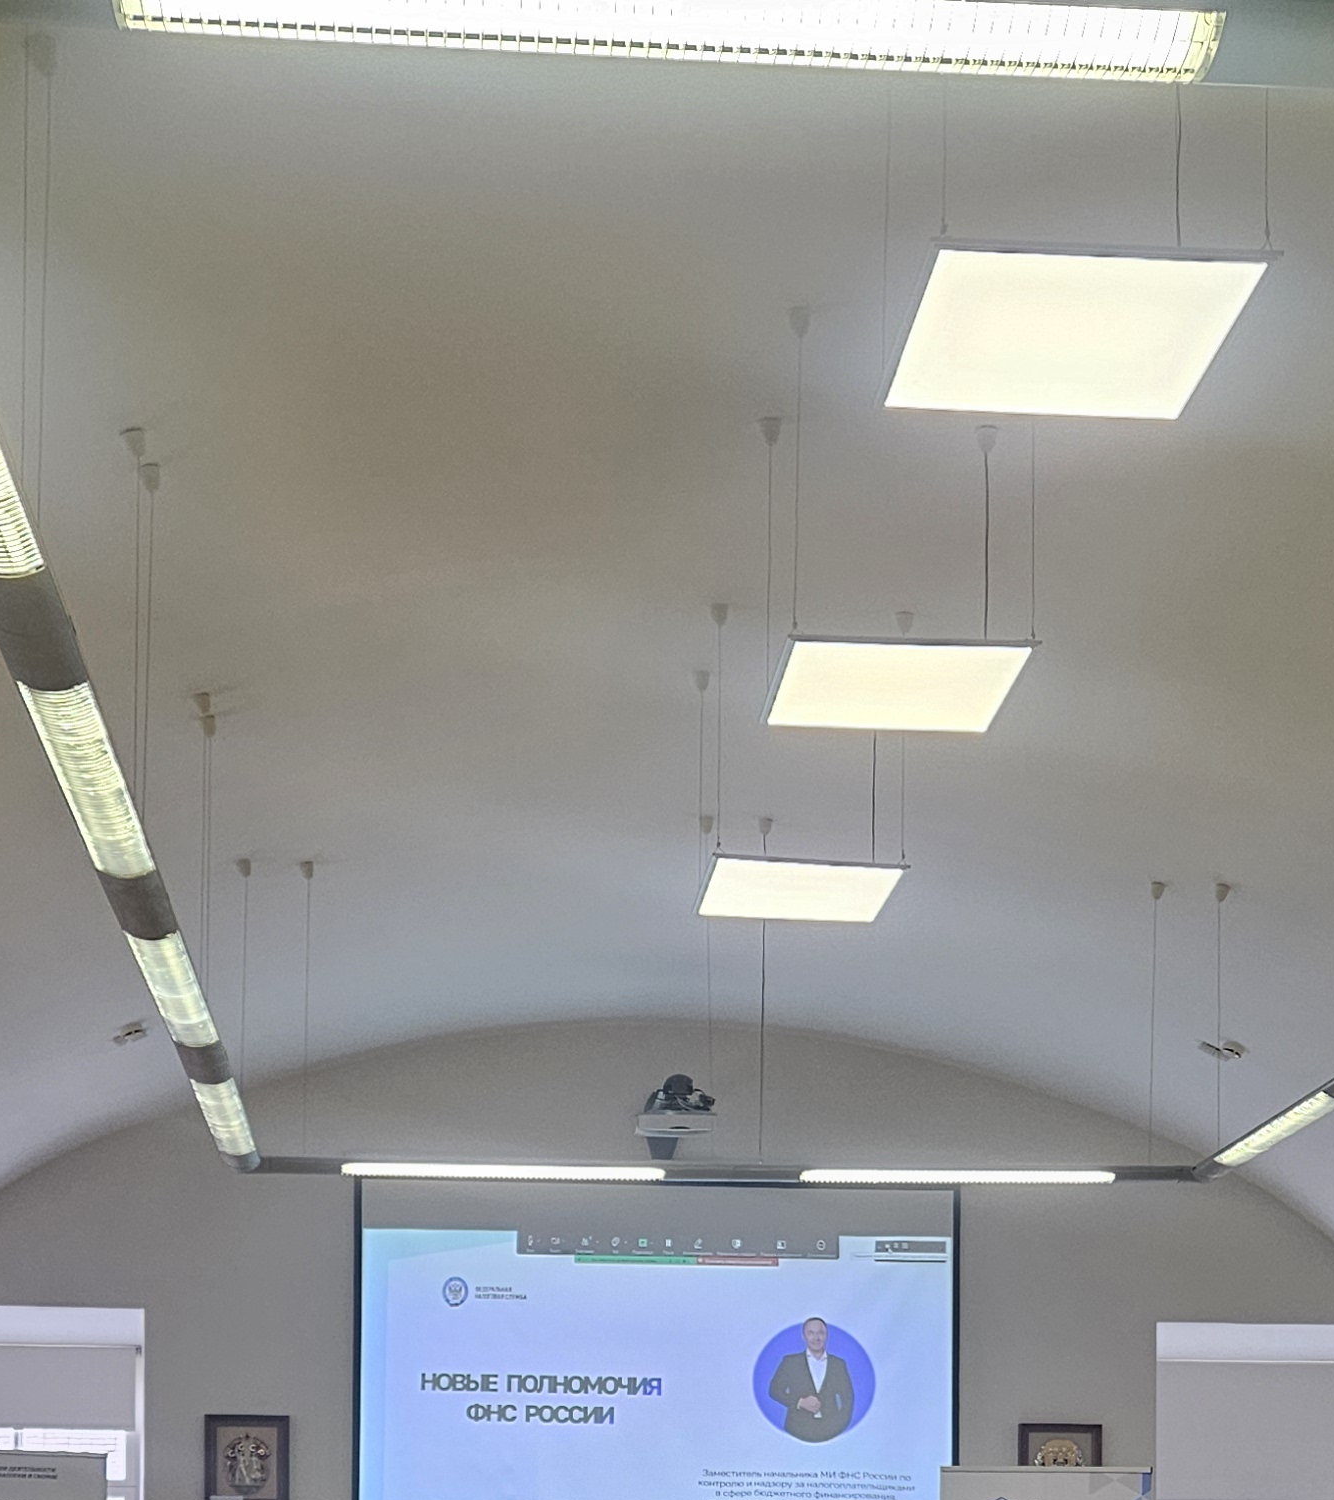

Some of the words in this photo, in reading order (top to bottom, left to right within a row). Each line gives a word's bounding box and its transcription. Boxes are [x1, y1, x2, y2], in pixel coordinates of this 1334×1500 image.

[420, 1372, 498, 1392] НОВЫЕ
[506, 1374, 663, 1396] ПОЛНОМОЧИЯ
[466, 1403, 517, 1422] ФНС
[525, 1404, 615, 1425] РОССИИ
[702, 1469, 762, 1478] Заместитель
[764, 1471, 818, 1479] начальника
[820, 1471, 836, 1479] МИ
[838, 1471, 860, 1480] ФНС
[863, 1472, 897, 1481] России
[899, 1474, 911, 1482] по
[698, 1480, 744, 1488] контролю
[754, 1480, 792, 1490] надзору
[722, 1490, 752, 1500] сфере
[754, 1489, 812, 1499] бюджетного
